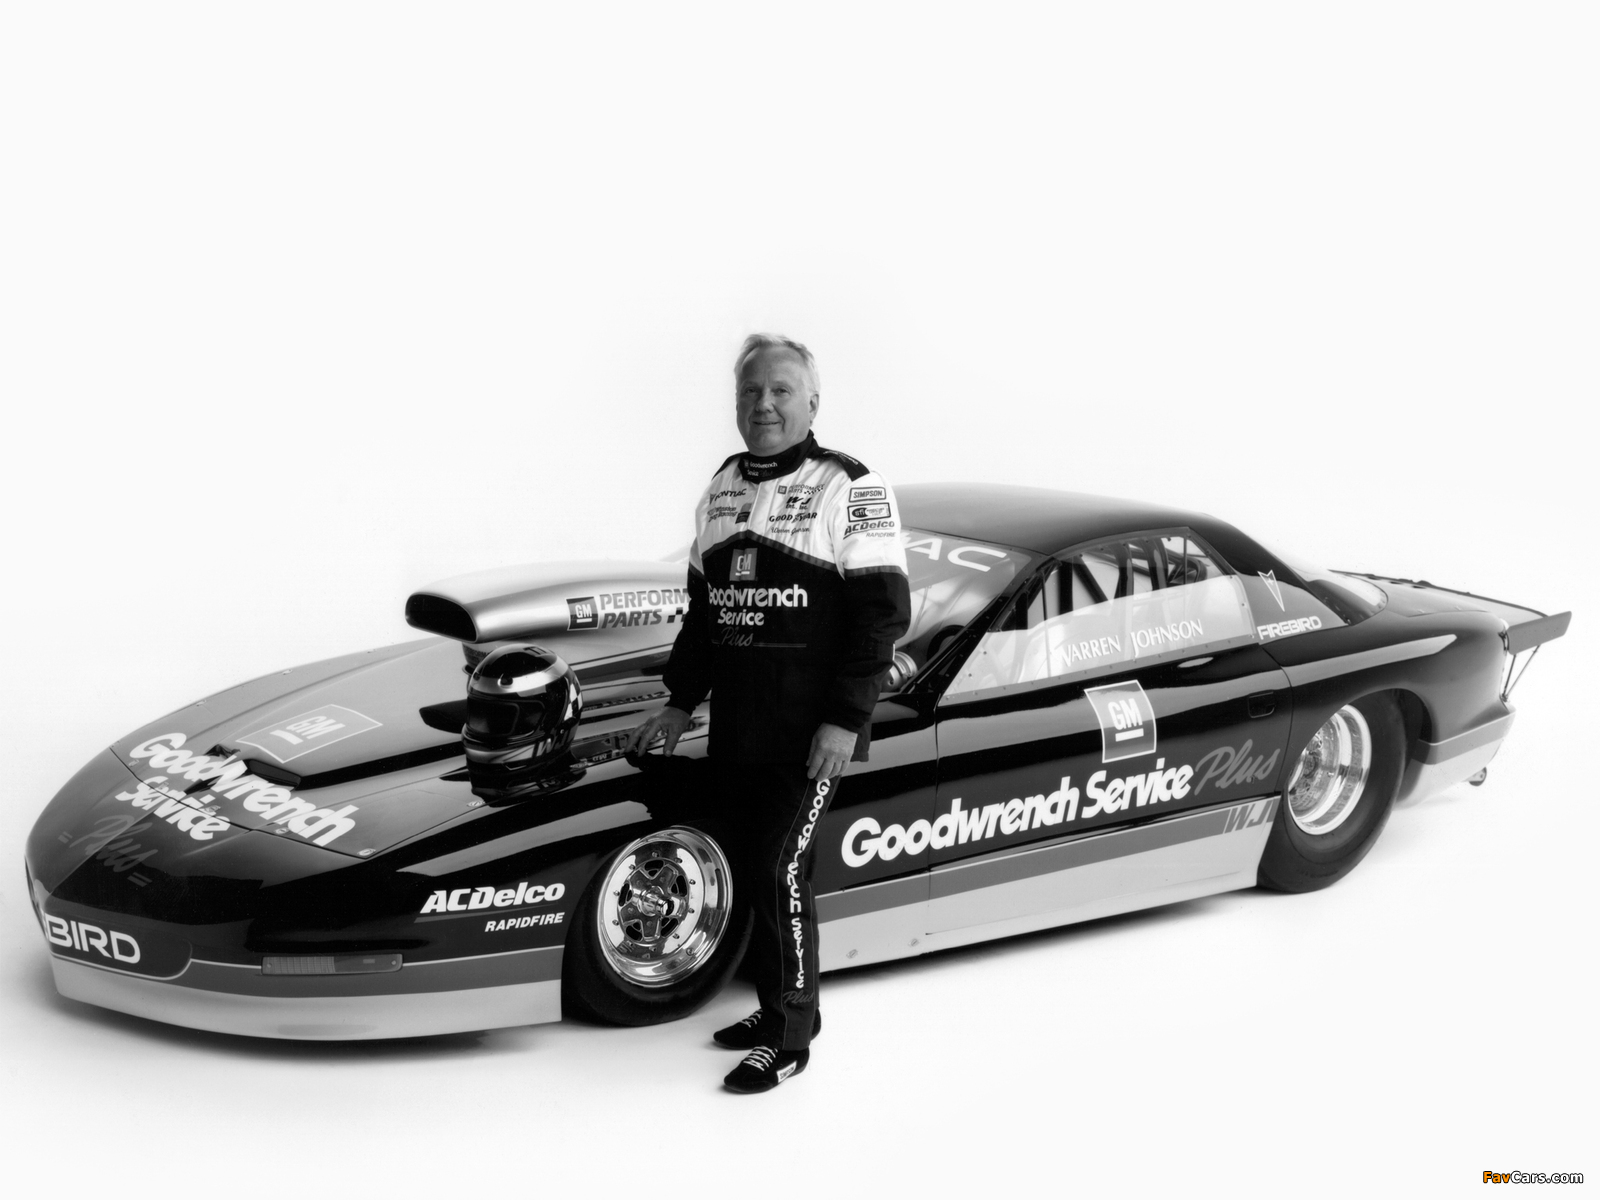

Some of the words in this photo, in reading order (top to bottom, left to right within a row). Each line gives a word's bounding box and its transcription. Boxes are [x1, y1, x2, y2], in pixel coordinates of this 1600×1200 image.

[853, 490, 883, 498] SIMPSON
[844, 521, 895, 536] ACDelco
[737, 554, 752, 571] GM
[707, 582, 808, 607] Goodwrench
[575, 603, 592, 618] GM
[602, 608, 662, 629] PARTS
[717, 607, 765, 626] Service
[721, 626, 754, 647] Plus
[1131, 619, 1204, 661] JOHNSON
[1257, 616, 1322, 640] FIREBIRD
[1107, 697, 1143, 731] GM
[286, 714, 344, 740] GM
[129, 732, 360, 847] Goodwrench
[115, 775, 231, 841] Service
[841, 776, 1080, 868] Goodwrench
[1081, 757, 1194, 820] Service
[1194, 738, 1280, 796] Plus
[69, 814, 158, 873] Plus
[420, 881, 566, 914] ACDelco
[484, 912, 564, 933] RAPIDFIRE
[783, 991, 815, 1005] Plus
